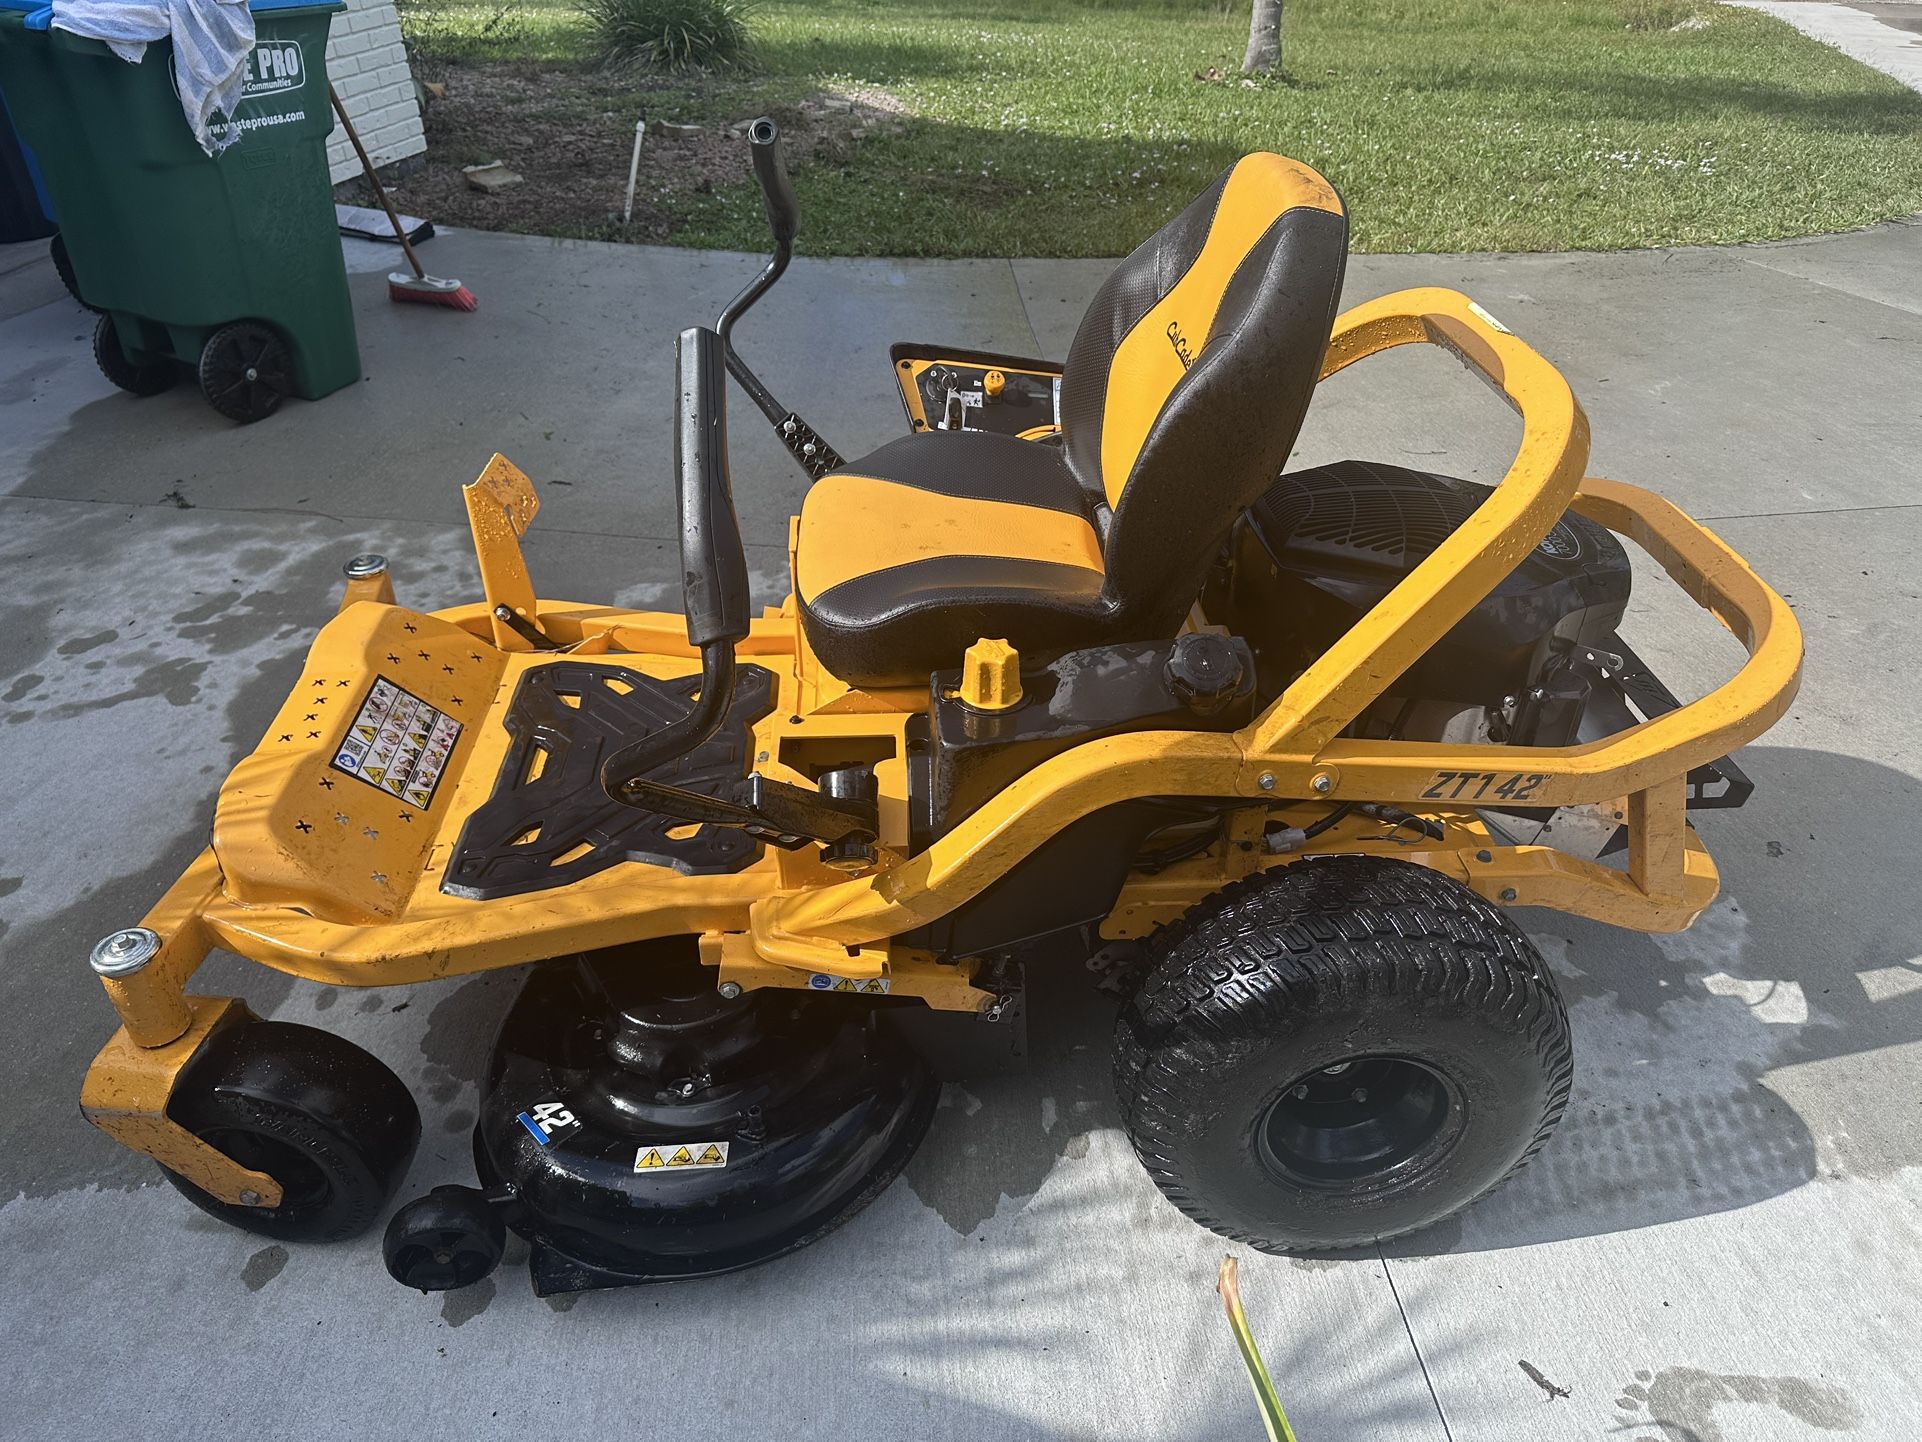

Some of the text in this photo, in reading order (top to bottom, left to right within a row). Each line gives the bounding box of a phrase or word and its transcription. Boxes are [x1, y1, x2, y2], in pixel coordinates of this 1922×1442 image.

[257, 47, 298, 79] PRO
[247, 78, 291, 92] Communities
[1422, 772, 1497, 799] ZT1
[532, 1102, 581, 1135] 42"
